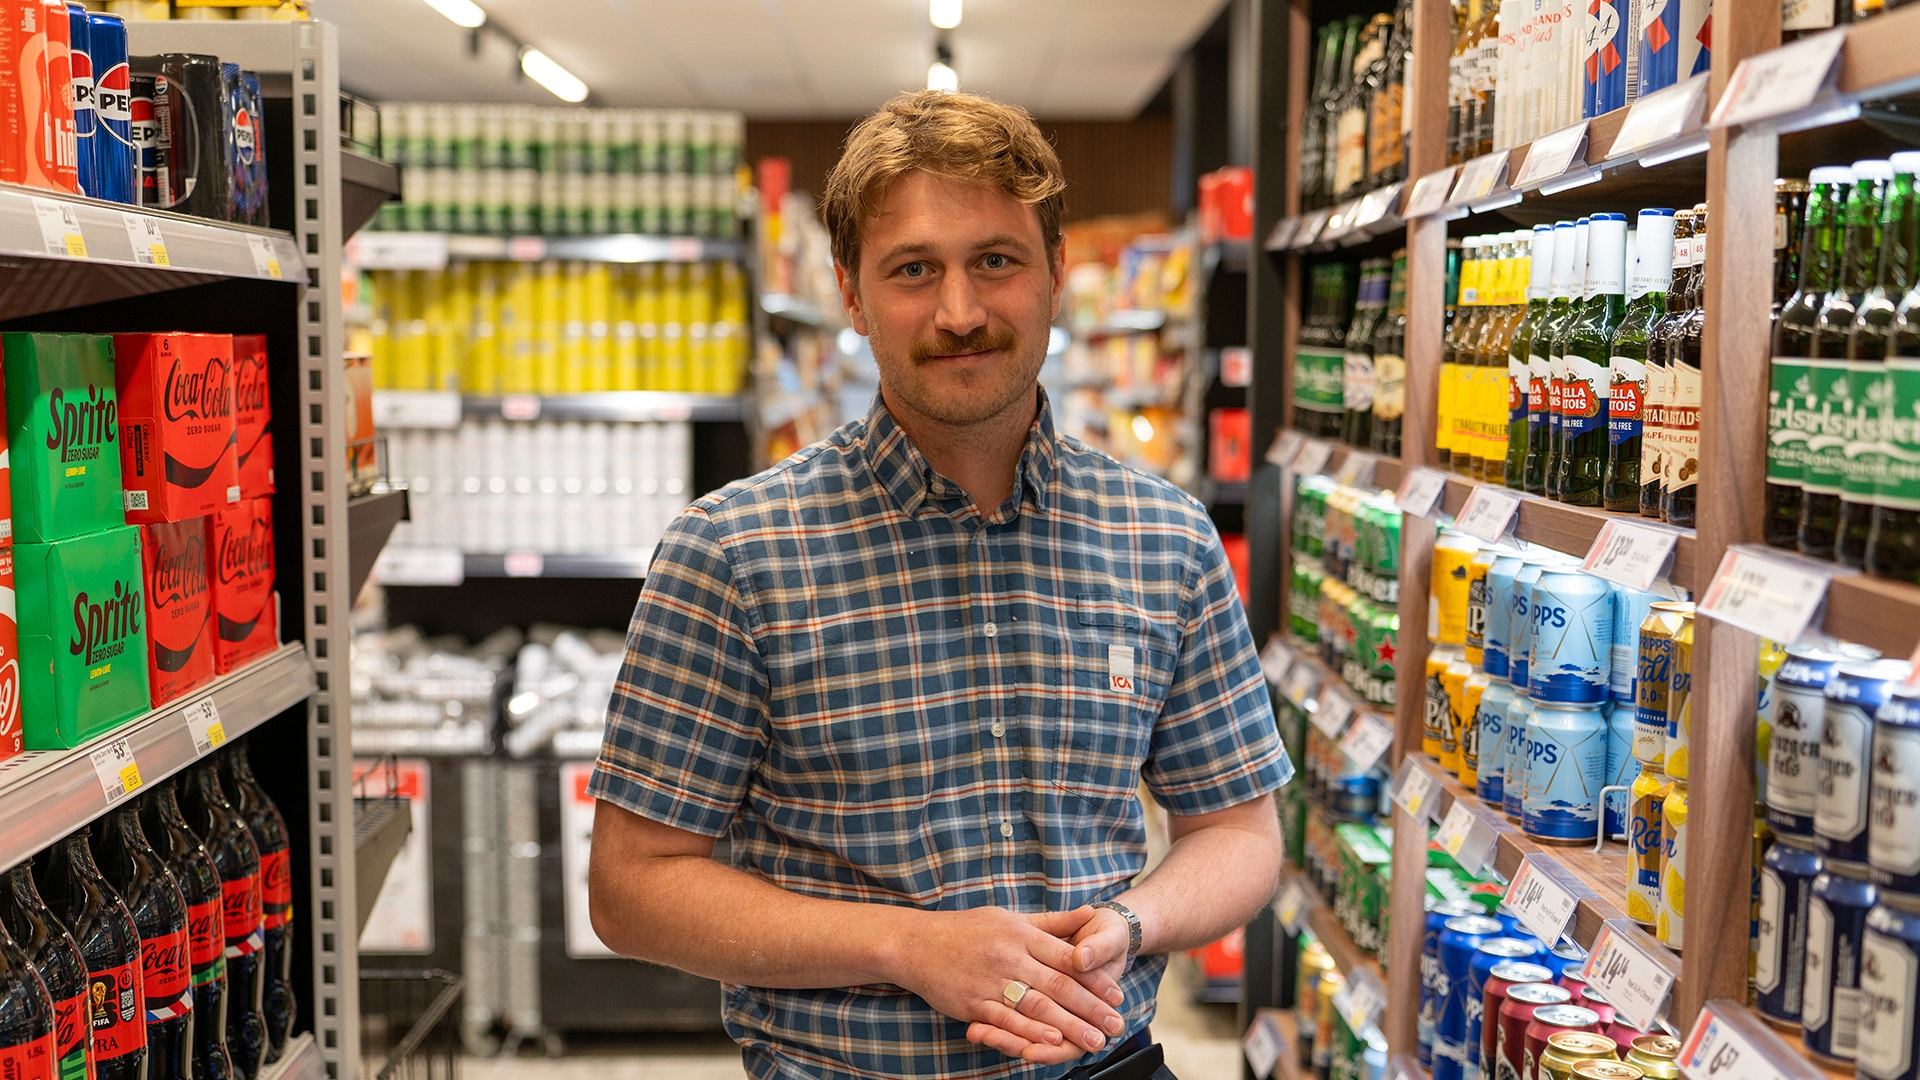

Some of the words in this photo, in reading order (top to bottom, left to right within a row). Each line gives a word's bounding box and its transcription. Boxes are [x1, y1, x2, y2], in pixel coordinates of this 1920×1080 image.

[1679, 248, 1688, 257] 48
[163, 339, 169, 351] 6
[46, 384, 116, 463] Sprite
[187, 425, 202, 435] ZERO
[204, 424, 221, 433] SUGAR
[1571, 419, 1583, 428] FREE
[1618, 422, 1632, 430] FREE
[67, 448, 81, 462] ZERO
[81, 446, 99, 461] SUGAR
[171, 606, 184, 619] ZERO
[185, 601, 199, 614] SUGAR
[70, 580, 141, 666] Sprite
[91, 648, 107, 664] ZERO
[107, 641, 125, 659] SUGAR
[1112, 675, 1132, 690] ICA
[158, 975, 177, 985] ZERO
[92, 1018, 110, 1027] FIFA
[27, 1045, 45, 1060] 1.5L
